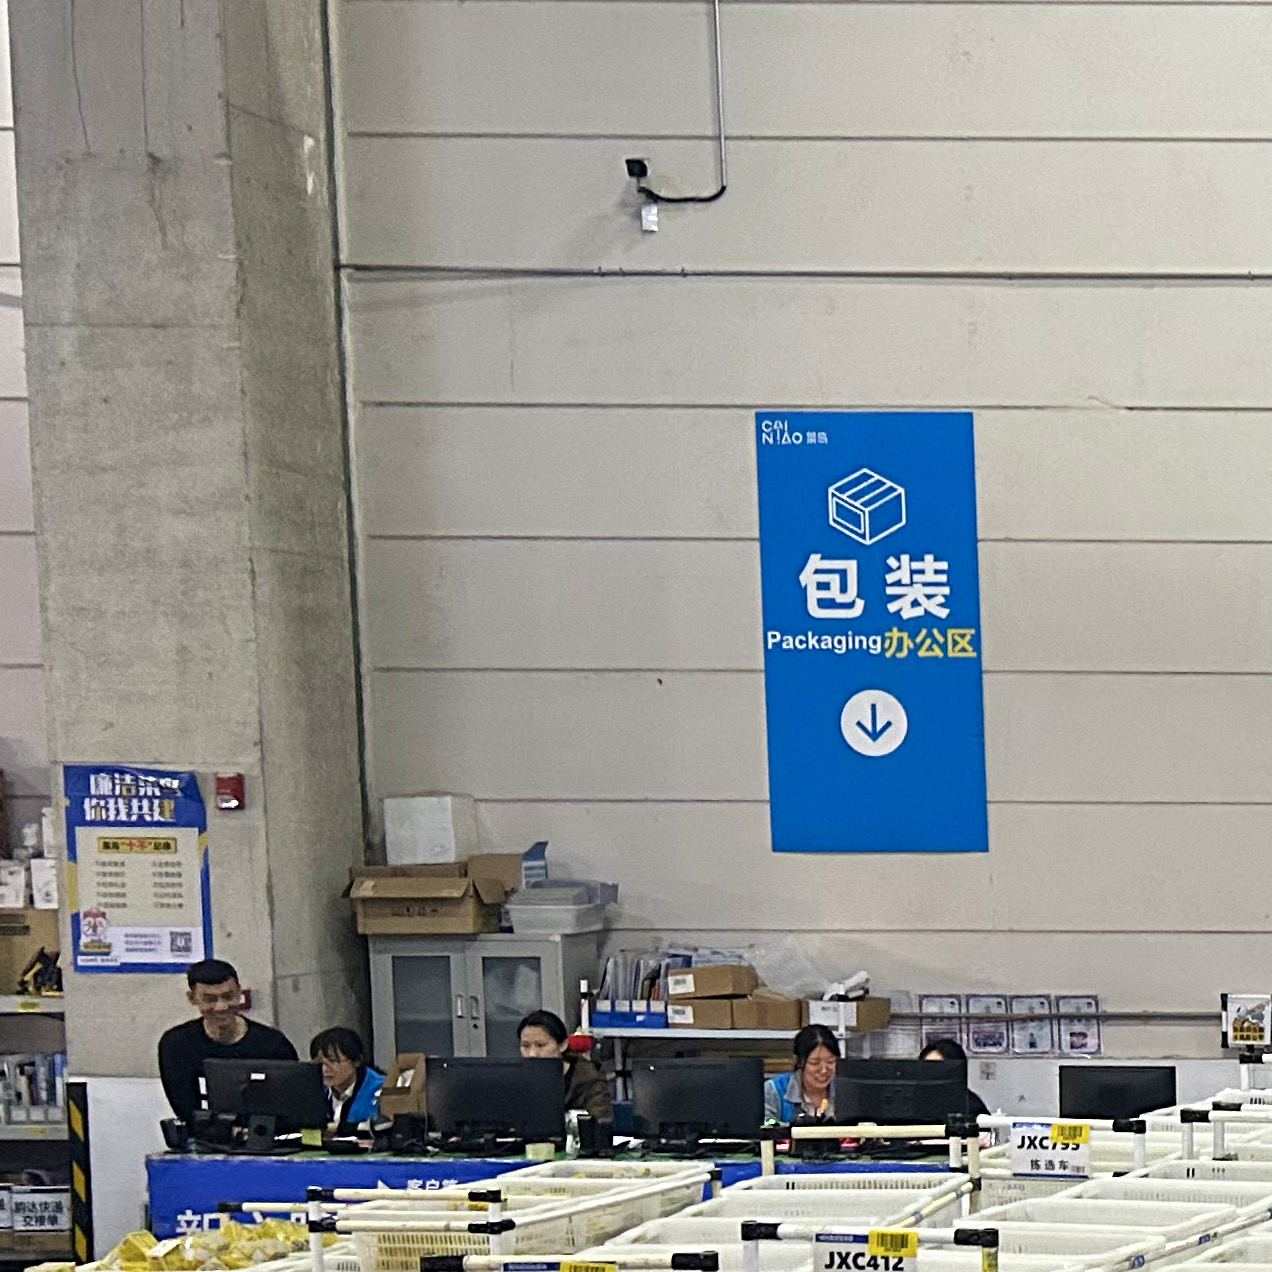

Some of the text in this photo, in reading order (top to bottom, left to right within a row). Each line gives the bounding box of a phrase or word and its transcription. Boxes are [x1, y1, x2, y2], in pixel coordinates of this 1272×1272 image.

[799, 553, 951, 620] 包装
[767, 627, 977, 659] Packaging 办公区
[824, 1251, 905, 1271] JXC412
